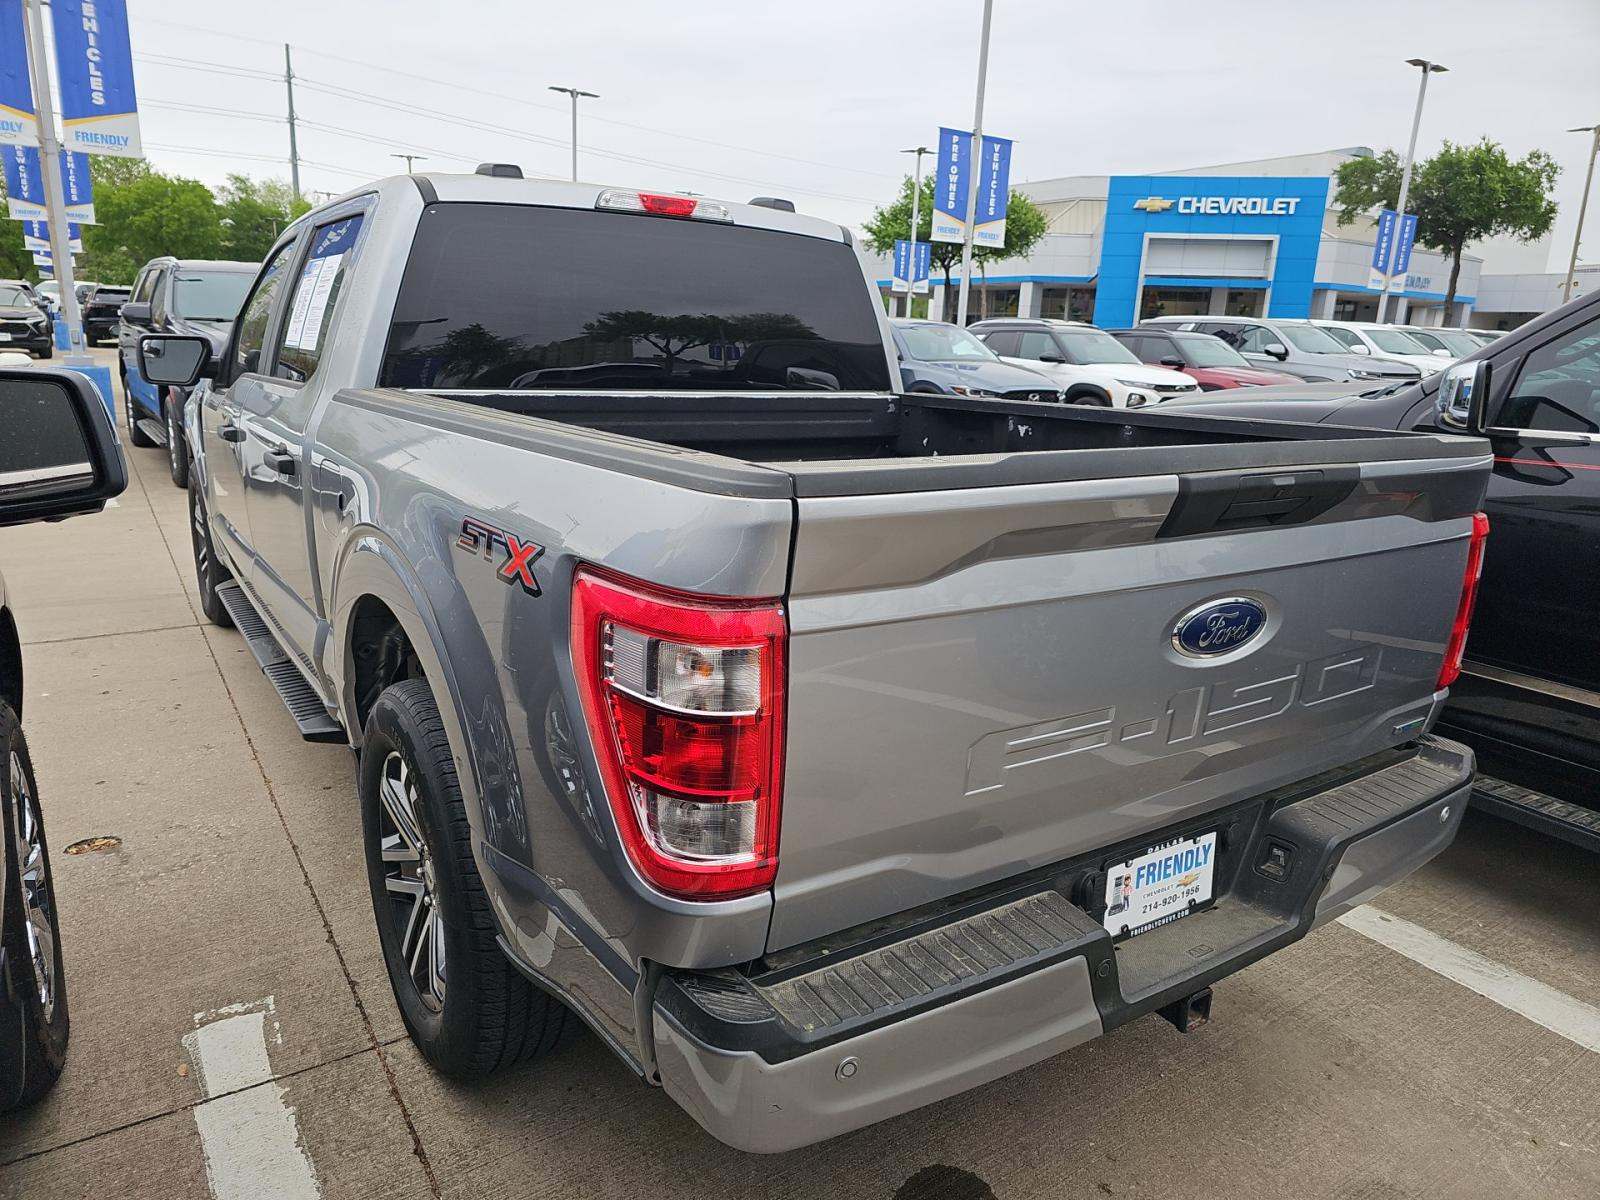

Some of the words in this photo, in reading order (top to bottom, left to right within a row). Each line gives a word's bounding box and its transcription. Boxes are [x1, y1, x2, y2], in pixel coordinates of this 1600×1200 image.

[82, 0, 105, 106] EHICLES
[75, 130, 129, 147] FRIENDLY
[951, 134, 960, 162] PRE
[66, 150, 78, 202] VEHICLES
[948, 164, 959, 209] OWNED
[988, 143, 1001, 216] VEHICLES
[1178, 197, 1301, 215] CHEVROLET
[456, 514, 546, 598] STX
[1199, 611, 1252, 648] Ford
[963, 646, 1383, 796] F-150
[1147, 837, 1185, 854] DALLAS
[1135, 843, 1213, 890] FRIENDLY
[1142, 884, 1175, 899] CHEVROLET
[1142, 884, 1201, 914] 214-920-1956
[1130, 908, 1190, 937] FRIENDLYCHEVY.COM
